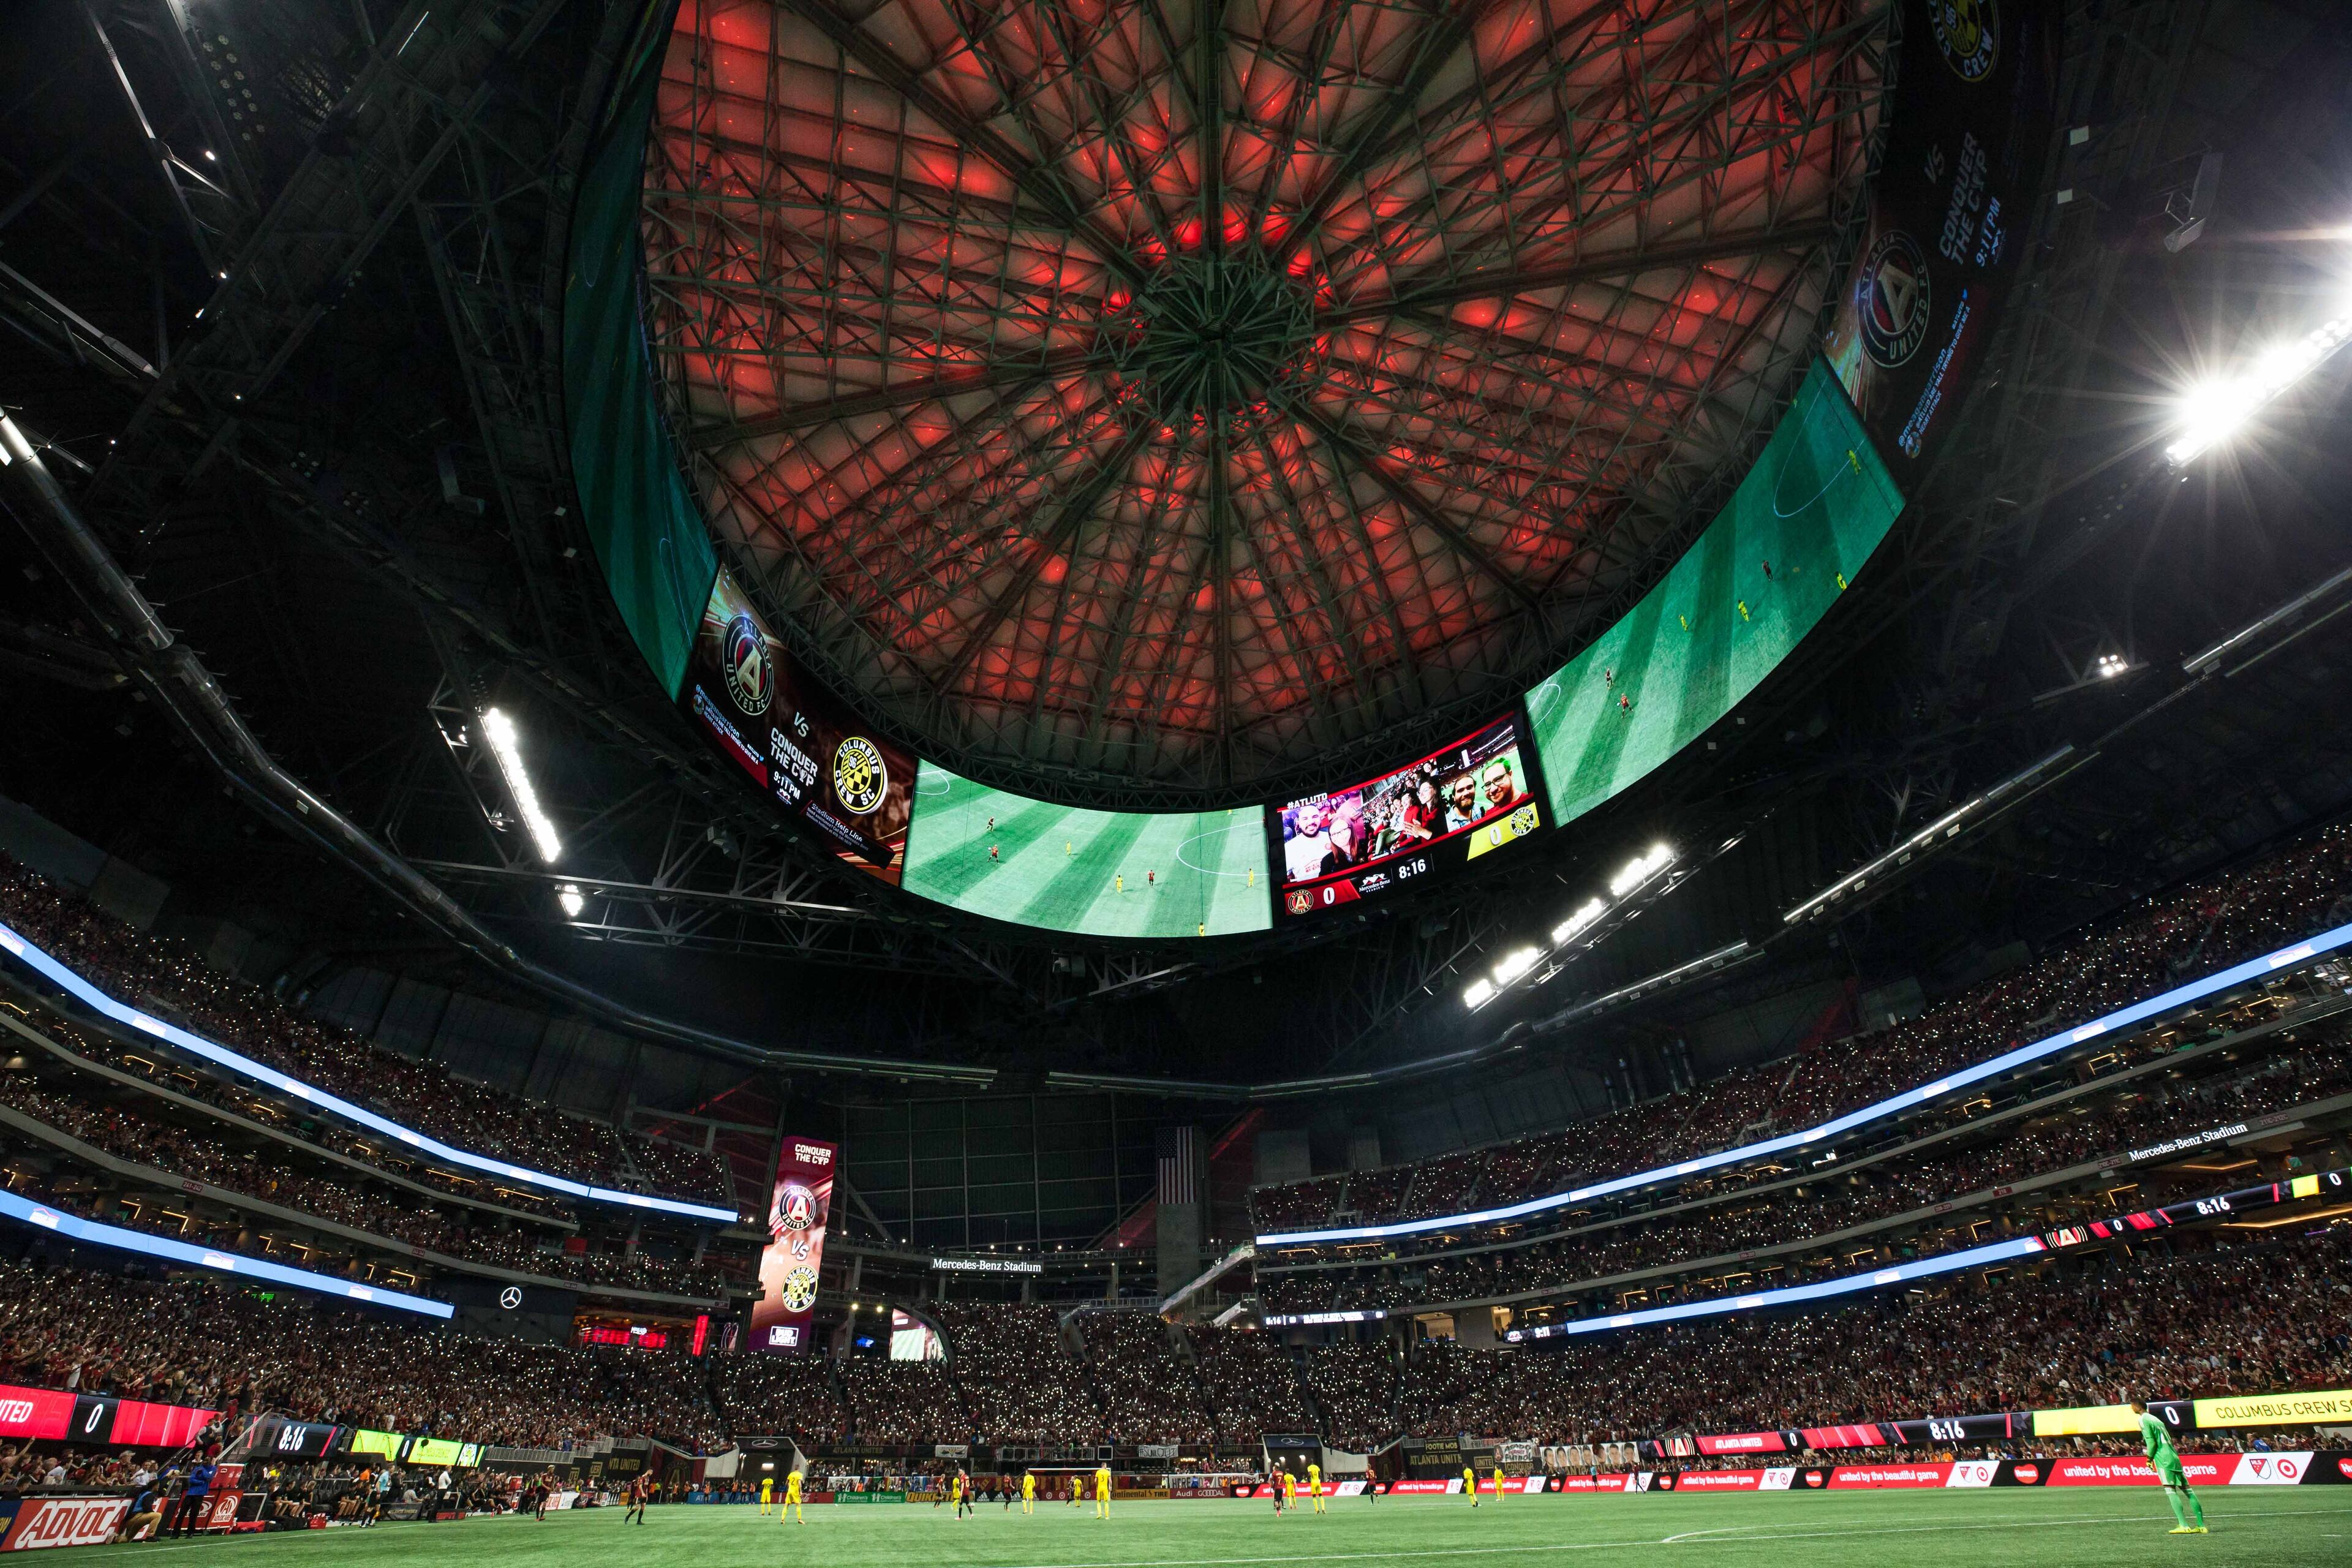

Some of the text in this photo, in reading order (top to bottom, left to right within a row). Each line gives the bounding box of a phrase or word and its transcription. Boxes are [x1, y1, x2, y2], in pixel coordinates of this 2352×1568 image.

[1964, 26, 1993, 77] CREW
[1940, 130, 1980, 258] CONQUER
[1951, 212, 1975, 266] THE
[1860, 233, 1896, 299] ATLANTA
[1889, 265, 1928, 360] UNITED FC
[744, 619, 772, 669] ATLANTA
[726, 663, 765, 712] UNITED FC
[794, 712, 809, 737] VS
[771, 727, 818, 777] CONQUER
[771, 741, 790, 769] THE
[839, 739, 880, 774] COLUMBUS
[848, 755, 857, 769] 96
[774, 771, 788, 790] 9:11
[788, 783, 801, 800] PM
[835, 769, 875, 805] CREW SC
[1287, 793, 1328, 810] #ATLUTD
[812, 803, 862, 842] Stadium Help Line
[1490, 826, 1501, 845] 0
[1398, 859, 1426, 879] 8:16
[1359, 879, 1390, 892] Mercedes-Benz
[1323, 887, 1335, 905] 0
[795, 1144, 832, 1158] CONQUER
[2128, 1123, 2248, 1162] Mercedes-Benz Stadium
[795, 1152, 811, 1163] THE
[2329, 1172, 2342, 1186] 0
[2196, 1196, 2231, 1215] 8:16
[782, 1213, 804, 1228] UNITED
[2114, 1219, 2123, 1231] 0
[791, 1239, 810, 1261] VS
[933, 1259, 1041, 1272] Mercedes-Benz Stadium
[785, 1267, 816, 1284] COLUMBUS
[783, 1291, 799, 1308] CREW
[1265, 1316, 1281, 1325] 8:16
[85, 1404, 104, 1433] 0
[2165, 1406, 2180, 1425] 0
[2215, 1403, 2292, 1419] COLUMBUS
[2293, 1400, 2337, 1414] CREW
[279, 1425, 307, 1451] 8:16
[1789, 1433, 1797, 1446] 0
[1929, 1420, 1965, 1441] 8:16
[1716, 1438, 1762, 1449] ATLANTA UNITED
[1410, 1455, 1439, 1465] ATLANTA
[1715, 1475, 1738, 1483] beautiful
[1738, 1476, 1754, 1485] game
[1839, 1469, 1939, 1482] united by the beautiful game
[2064, 1465, 2097, 1477] united
[2097, 1465, 2111, 1478] by
[2111, 1464, 2129, 1476] the
[2182, 1464, 2217, 1477] game
[1111, 1491, 1147, 1499] Continental
[17, 1501, 132, 1546] ADVOCA
